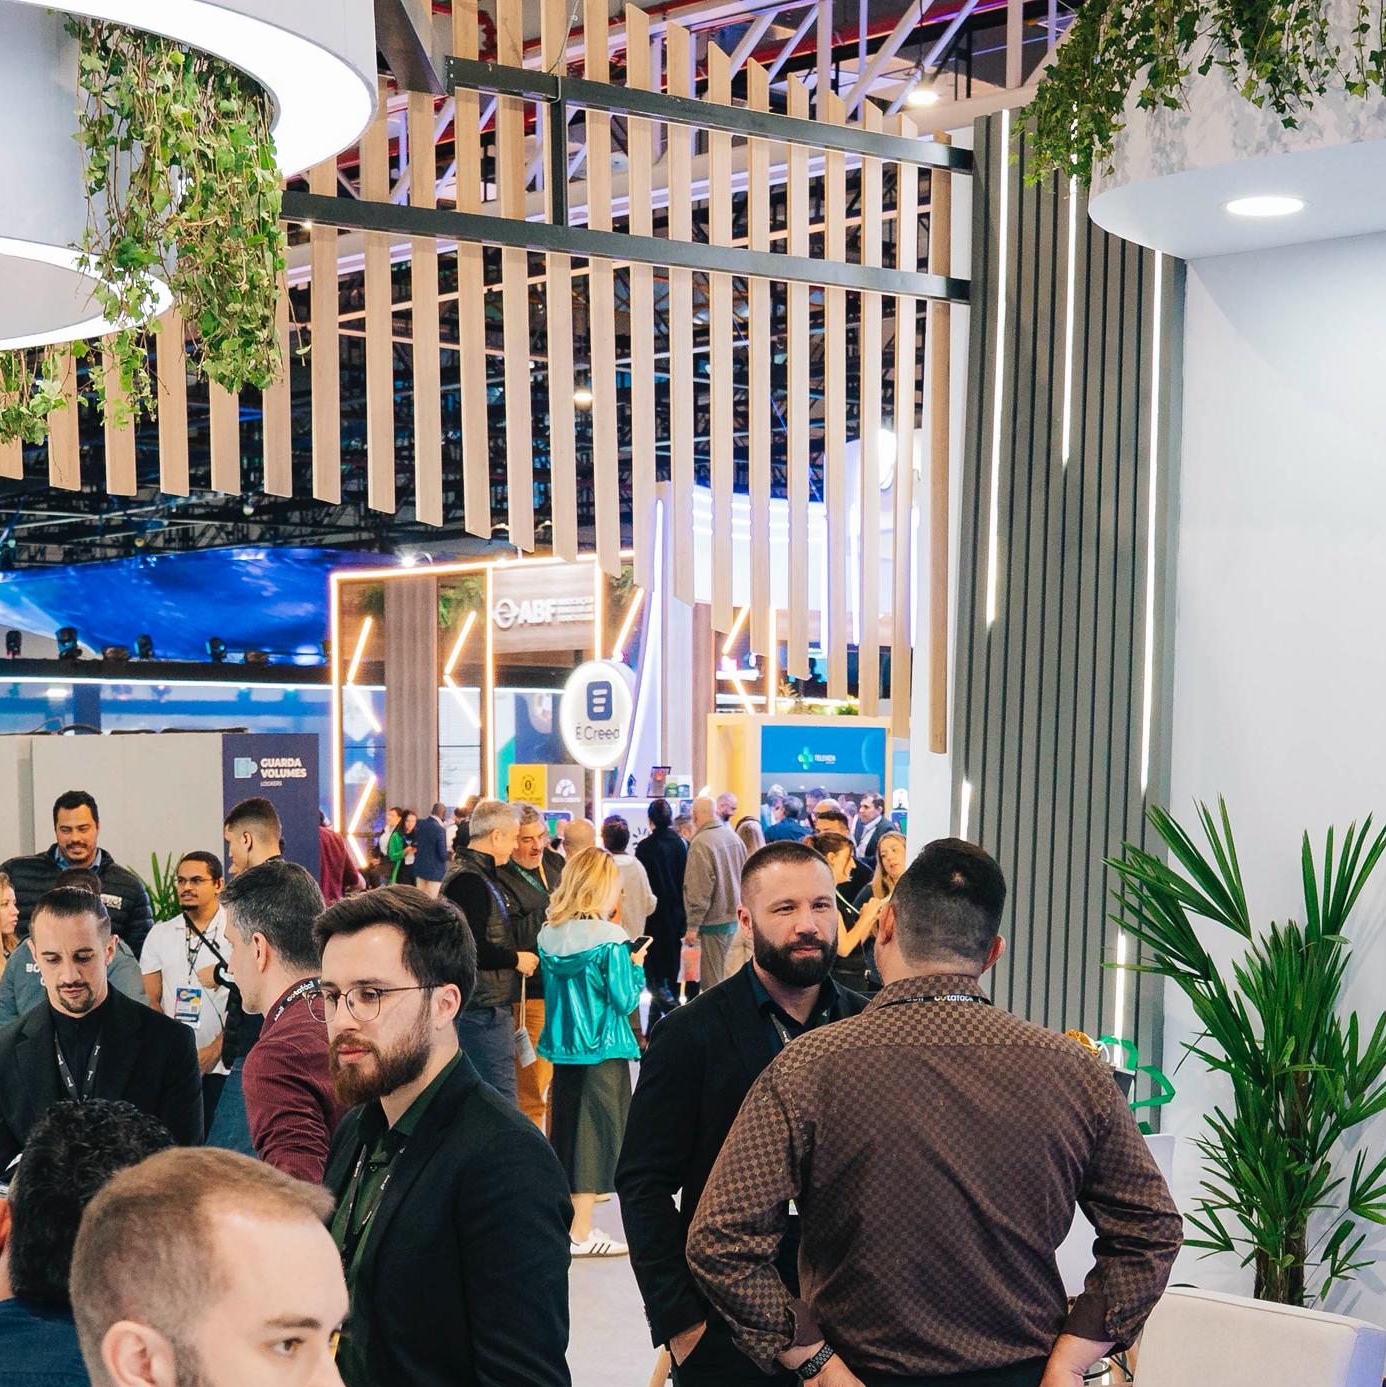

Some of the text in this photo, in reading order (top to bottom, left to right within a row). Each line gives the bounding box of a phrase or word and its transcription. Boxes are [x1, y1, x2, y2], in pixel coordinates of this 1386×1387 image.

[517, 599, 556, 624] ABF
[260, 757, 302, 768] GUARDA
[260, 768, 307, 778] VOLUMES
